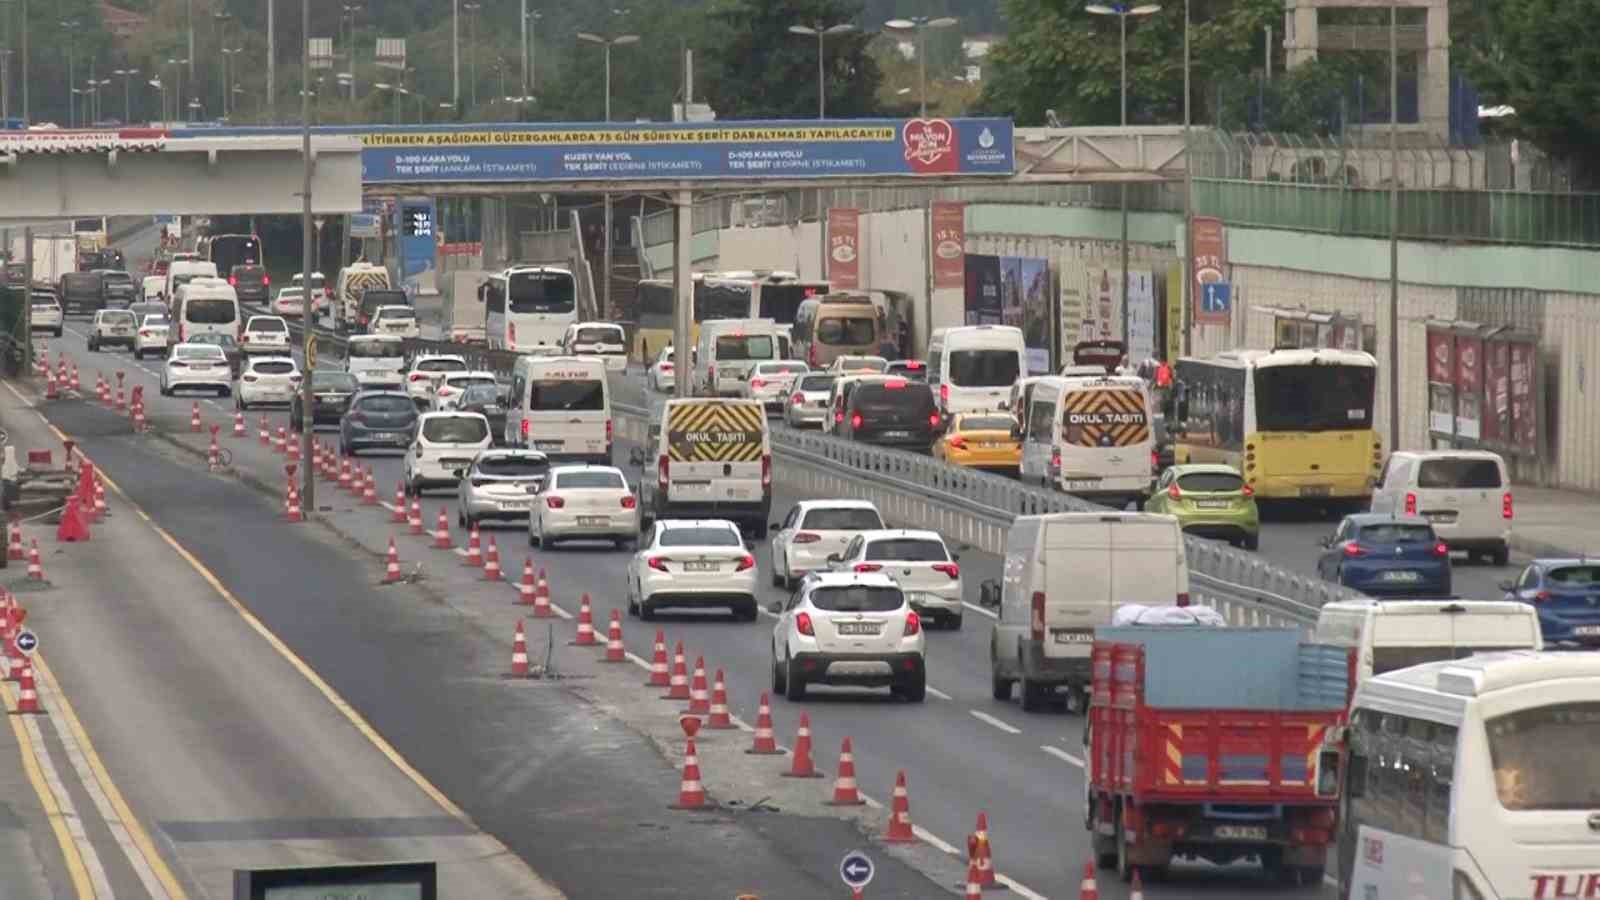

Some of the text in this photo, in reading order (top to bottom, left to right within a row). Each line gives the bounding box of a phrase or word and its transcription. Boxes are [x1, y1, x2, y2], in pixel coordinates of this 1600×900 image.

[370, 134, 424, 145] İTİBAREN
[426, 132, 492, 145] AŞAĞIDAKİ
[599, 133, 613, 142] 75
[615, 131, 640, 142] GÜN
[640, 130, 696, 141] SÜREYLE
[696, 128, 729, 141] ŞERİT
[732, 128, 807, 140] DARALTMASI
[594, 152, 614, 161] YAN
[564, 163, 582, 172] TEK
[728, 160, 745, 169] TEK
[395, 165, 413, 174] TEK
[1069, 413, 1144, 425] OKUL TAŞITI
[685, 431, 746, 443] OKUL TAŞITI
